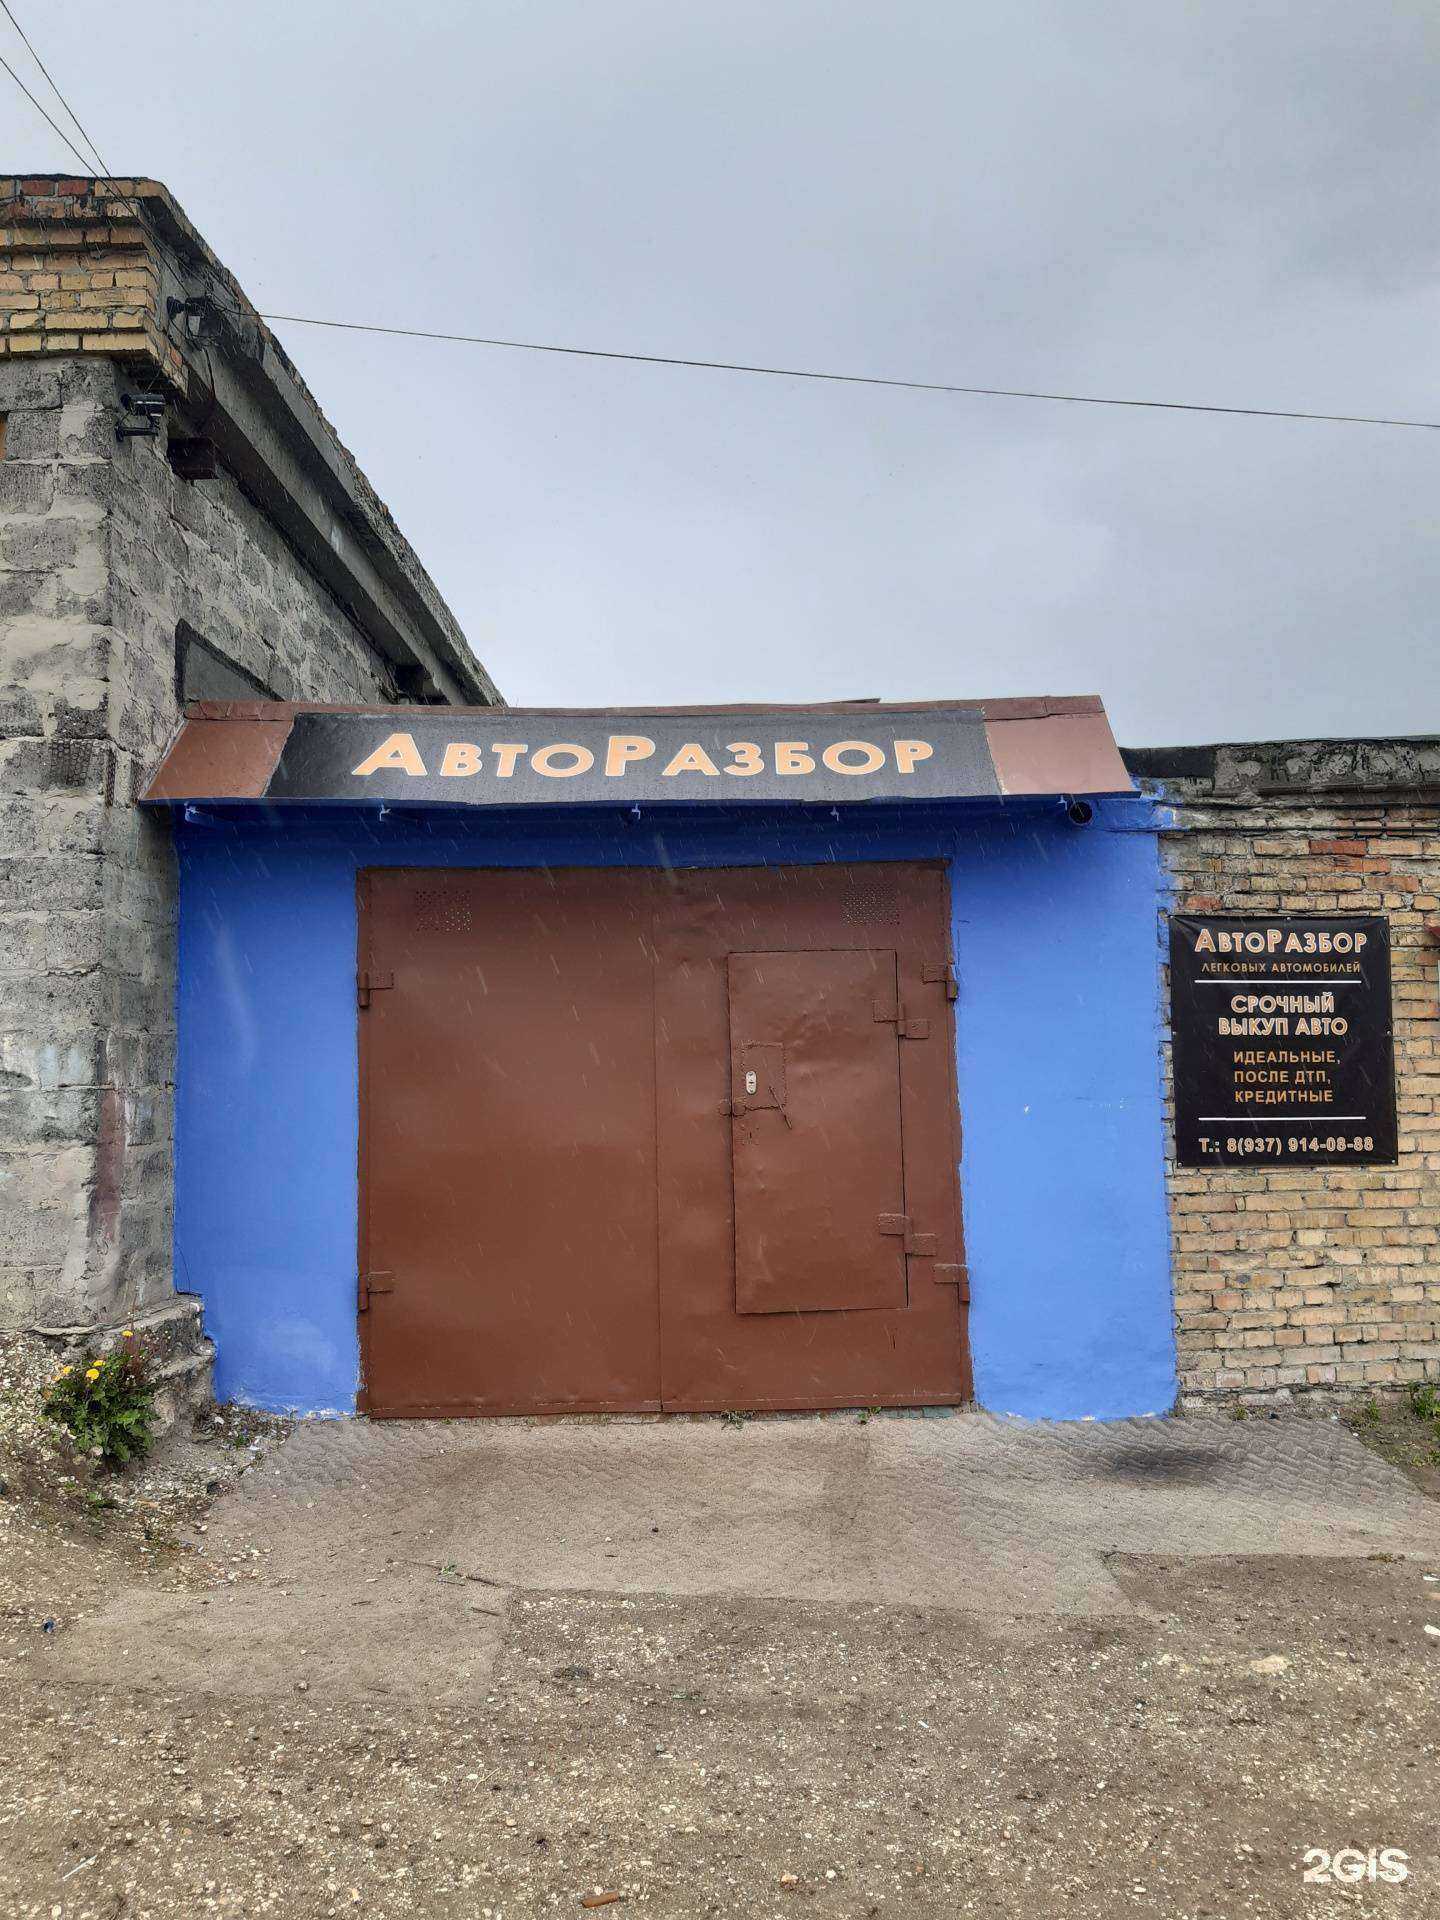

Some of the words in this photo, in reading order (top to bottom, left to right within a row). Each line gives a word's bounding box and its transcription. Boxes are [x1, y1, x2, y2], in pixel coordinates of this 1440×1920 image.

[1201, 963, 1266, 973] ЛЕГКОВЫХ
[1271, 961, 1361, 973] АВТОМОБИЛЕЙ
[1230, 991, 1335, 1014] СРОЧНЫЙ
[1218, 1017, 1289, 1036] ВЫКУП
[1294, 1017, 1348, 1036] АВТО
[1233, 1051, 1341, 1065] ИДЕАЛЬНЫЕ,
[1234, 1070, 1289, 1083] ПОСЛЕ
[1294, 1070, 1331, 1085] ДТП,
[1234, 1089, 1334, 1104] КРЕДИТНЫЕ
[1226, 1136, 1282, 1156] 8(937)
